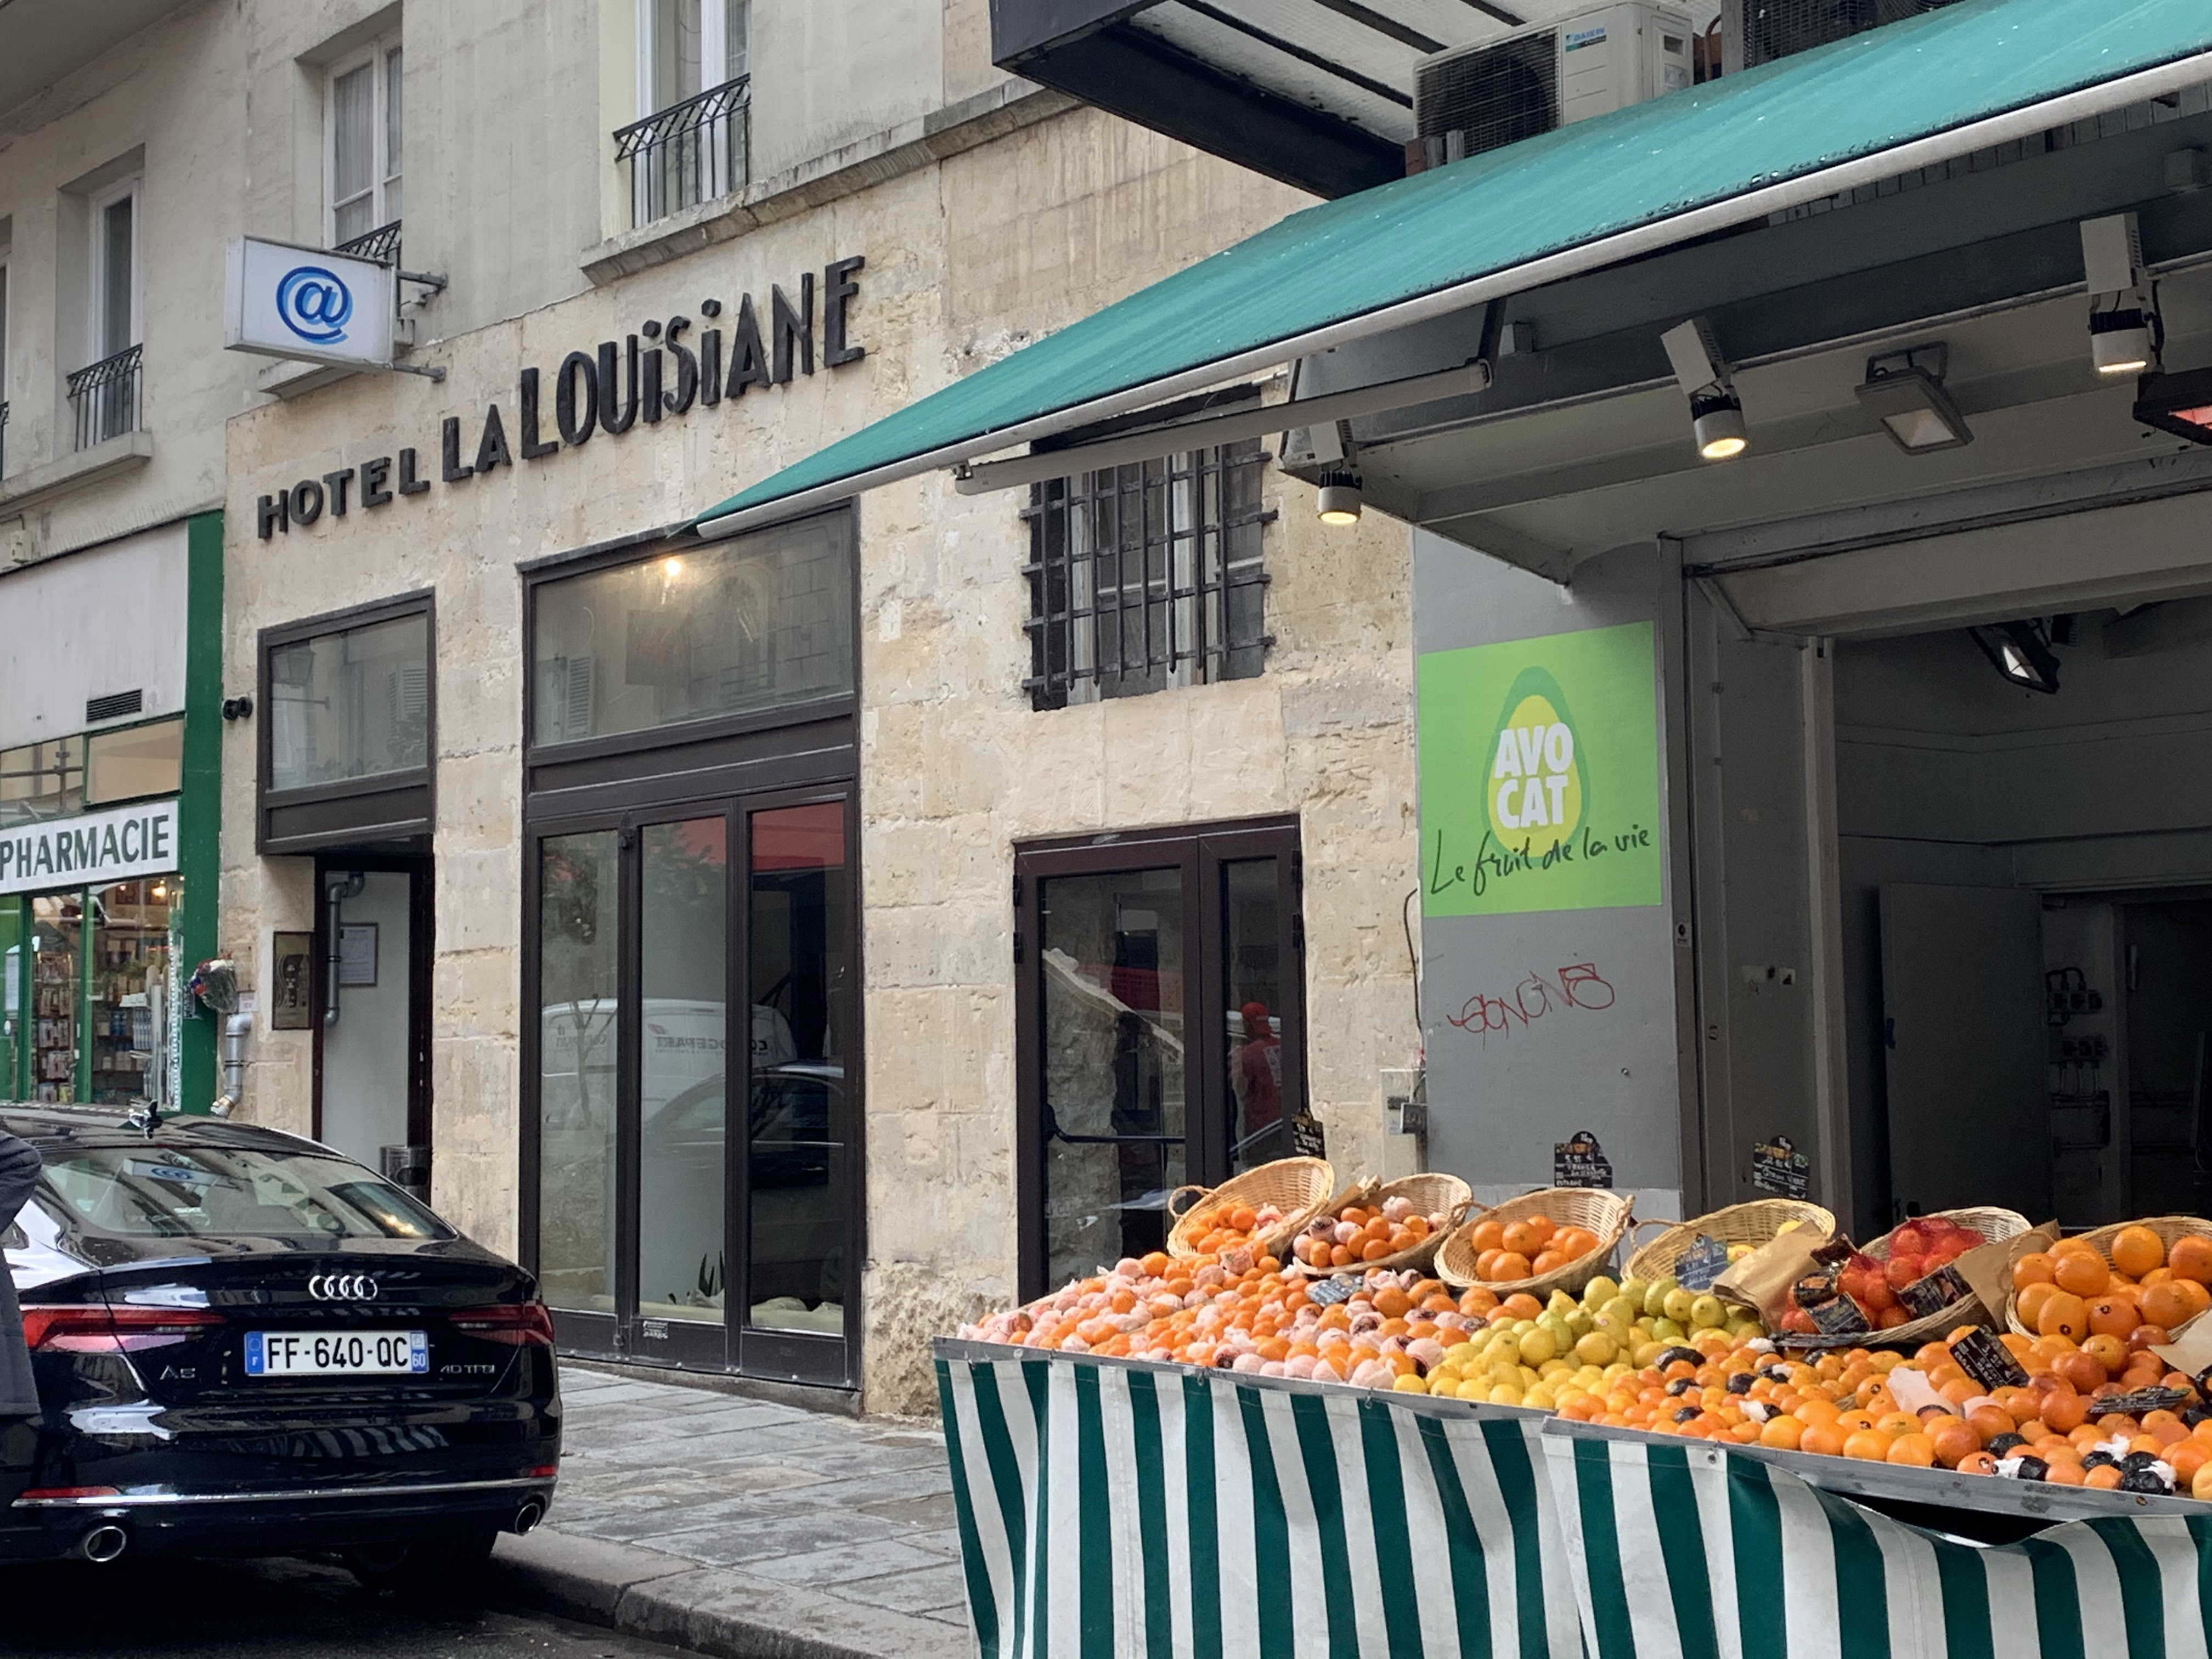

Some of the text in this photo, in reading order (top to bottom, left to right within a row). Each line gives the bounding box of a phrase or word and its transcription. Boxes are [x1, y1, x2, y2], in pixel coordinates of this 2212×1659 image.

[276, 266, 354, 345] @
[257, 448, 431, 539] HOTEL
[442, 404, 512, 482] LA
[1494, 722, 1575, 779] AVO
[1496, 774, 1568, 829] CAT
[0, 815, 169, 881] PHARMACIE
[1430, 823, 1651, 896] Le fruit de la vie
[267, 1337, 408, 1369] FF-640-QC
[412, 1352, 426, 1368] 60
